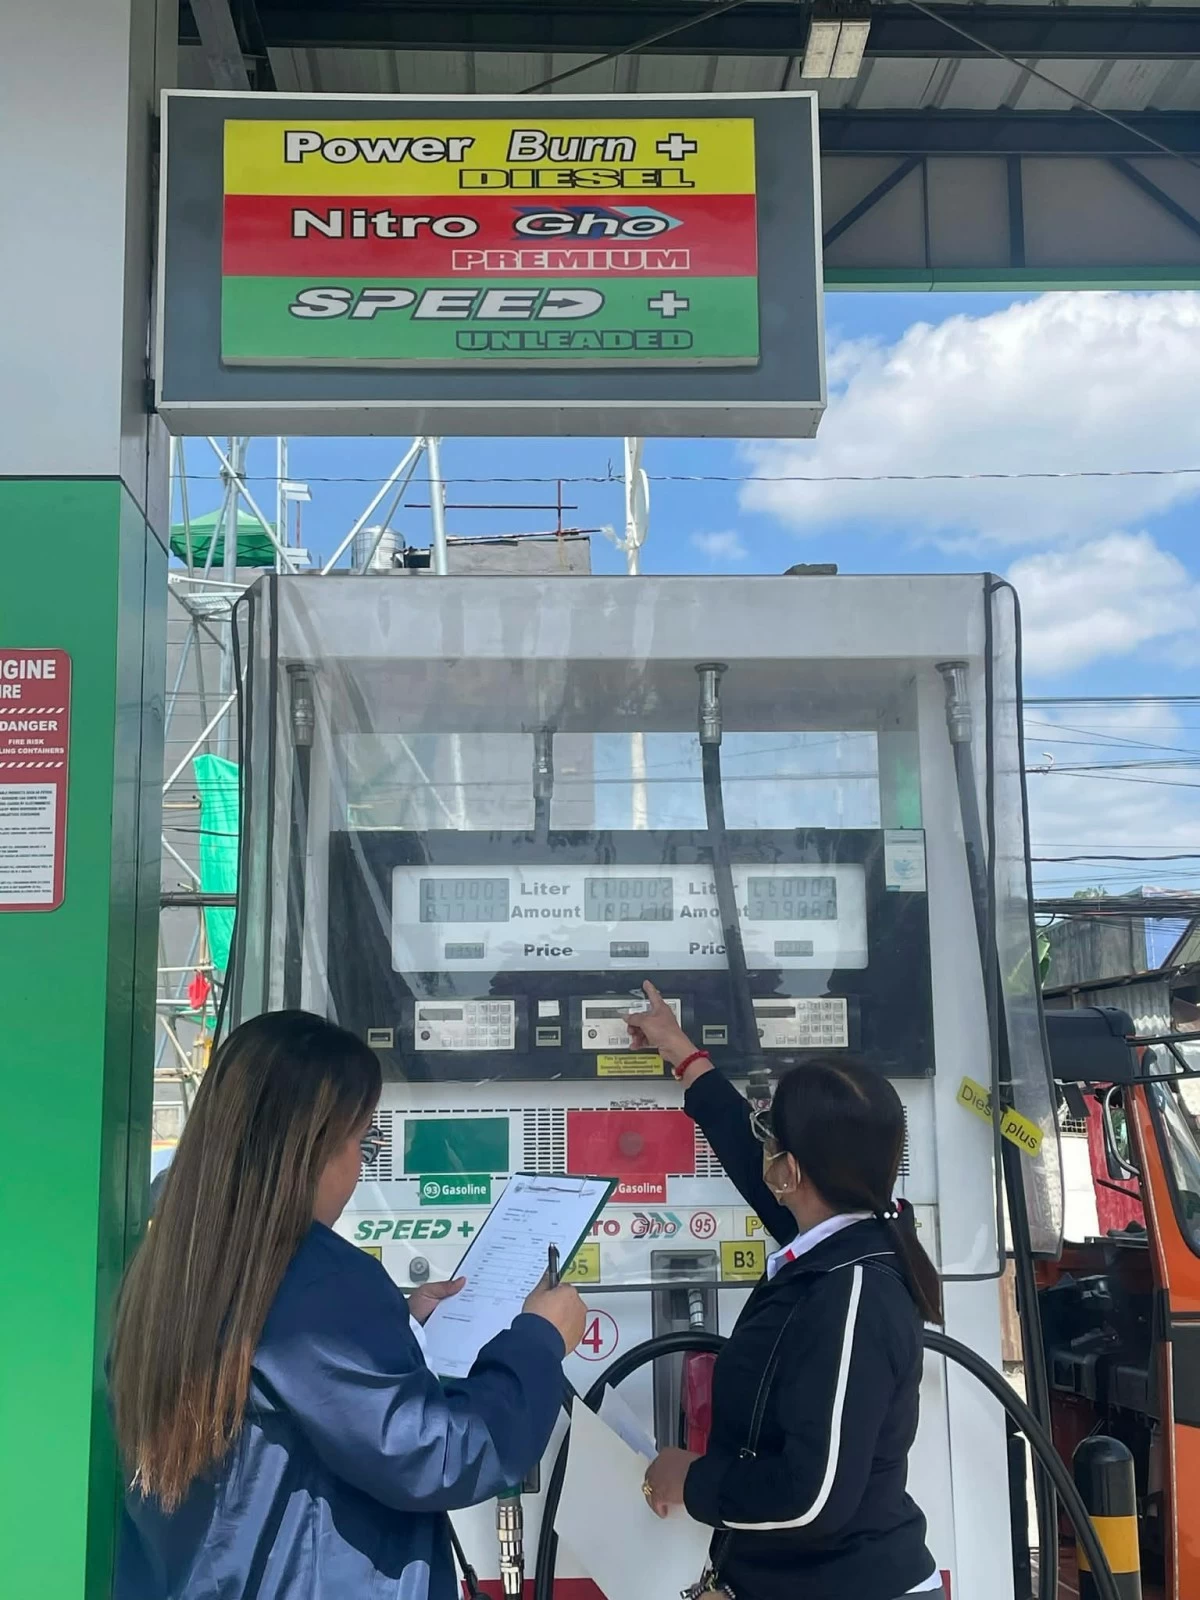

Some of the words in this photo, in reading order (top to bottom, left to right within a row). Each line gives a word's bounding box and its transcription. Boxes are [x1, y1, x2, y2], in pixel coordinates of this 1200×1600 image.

[284, 130, 476, 163] Power
[506, 129, 637, 162] Burn
[459, 168, 695, 189] DIESEL
[291, 208, 479, 239] Nitro
[512, 210, 669, 238] Gho
[452, 248, 690, 270] PREMIUM
[288, 286, 605, 321] SPEED
[456, 330, 693, 351] UNLEADED
[0, 720, 58, 731] DANGER
[520, 882, 571, 895] Liter
[689, 882, 738, 895] Lit
[511, 905, 581, 918] Amount
[680, 905, 749, 918] Amot
[523, 943, 573, 956] Price
[689, 942, 726, 955] Pric
[962, 1084, 1005, 1125] Diesl
[1005, 1122, 1038, 1149] plus
[425, 1185, 438, 1195] 93
[442, 1183, 487, 1195] Gasoline
[618, 1182, 663, 1194] Gasoline
[354, 1219, 452, 1240] SPEED
[631, 1217, 677, 1235] Gho
[695, 1218, 712, 1233] 95
[734, 1250, 755, 1268] B3
[581, 1316, 604, 1354] 4
